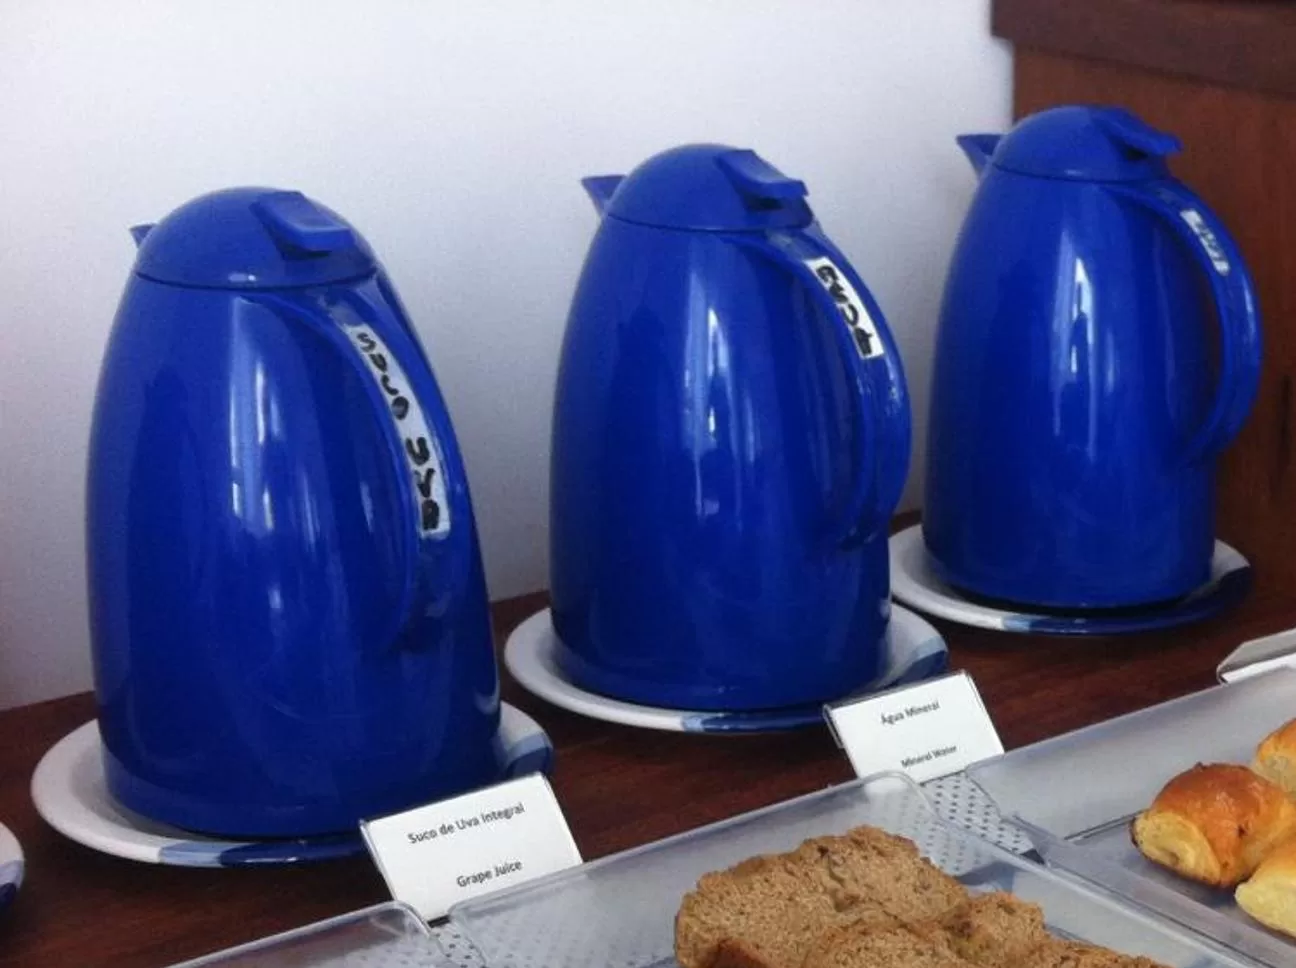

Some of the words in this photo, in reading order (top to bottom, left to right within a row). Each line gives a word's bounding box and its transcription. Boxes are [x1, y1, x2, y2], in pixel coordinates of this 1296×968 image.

[905, 701, 940, 716] Mineral
[901, 752, 932, 767] Mineral
[408, 830, 437, 844] Suco
[439, 823, 454, 836] de
[455, 818, 480, 831] Uva
[481, 802, 525, 823] Integral
[456, 870, 492, 888] Grape
[494, 860, 522, 878] Juice
